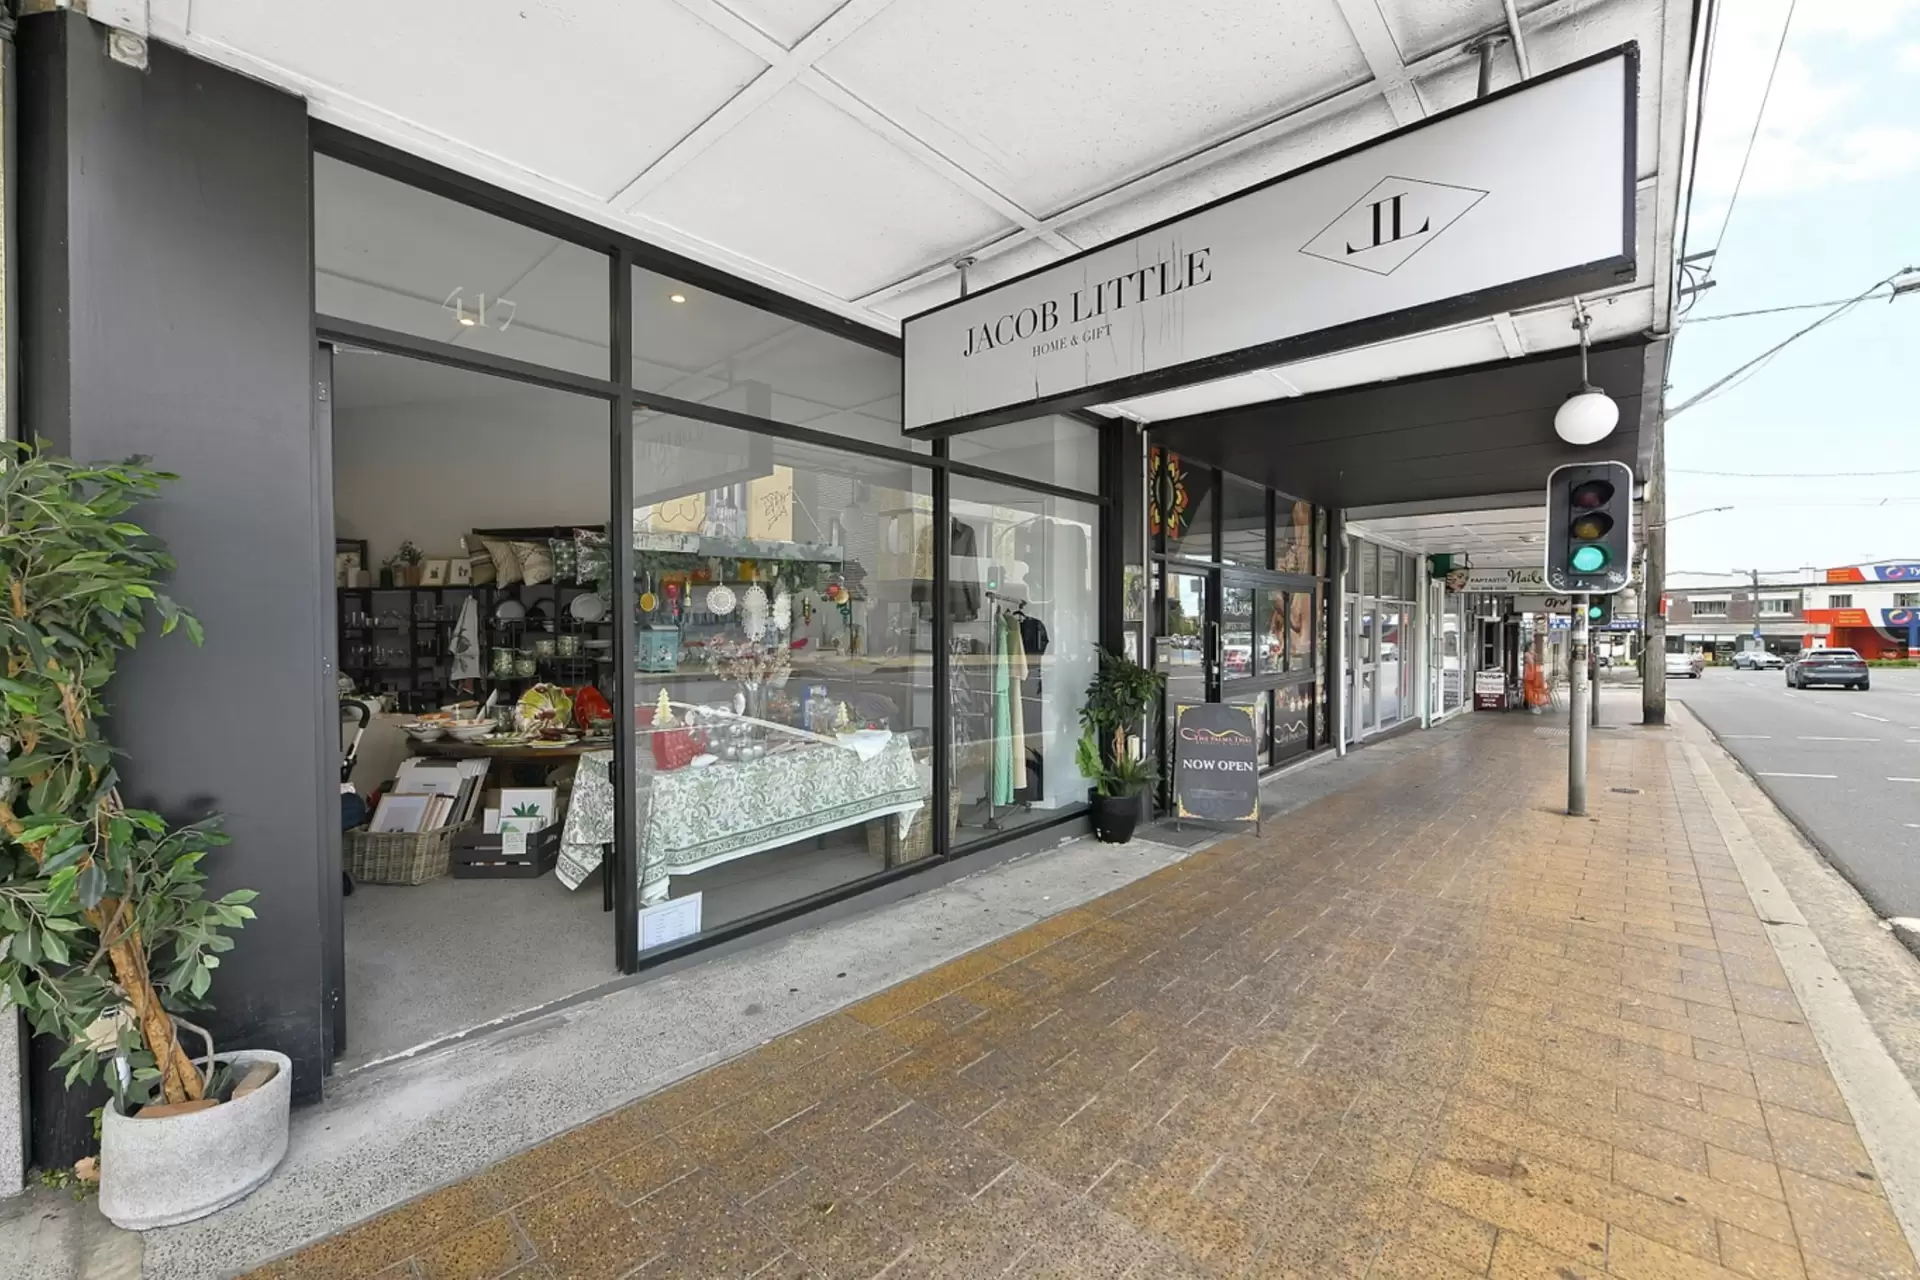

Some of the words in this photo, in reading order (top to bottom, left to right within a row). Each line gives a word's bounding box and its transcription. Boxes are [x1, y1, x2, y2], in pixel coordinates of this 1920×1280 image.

[963, 300, 1059, 357] JACOB
[1069, 248, 1212, 324] LITTLE
[1032, 337, 1067, 357] HOME
[1070, 334, 1079, 346] &
[1082, 324, 1113, 342] GIFT
[1507, 569, 1544, 584] Nails
[1183, 759, 1215, 770] NOW
[1218, 760, 1254, 772] OPEN
